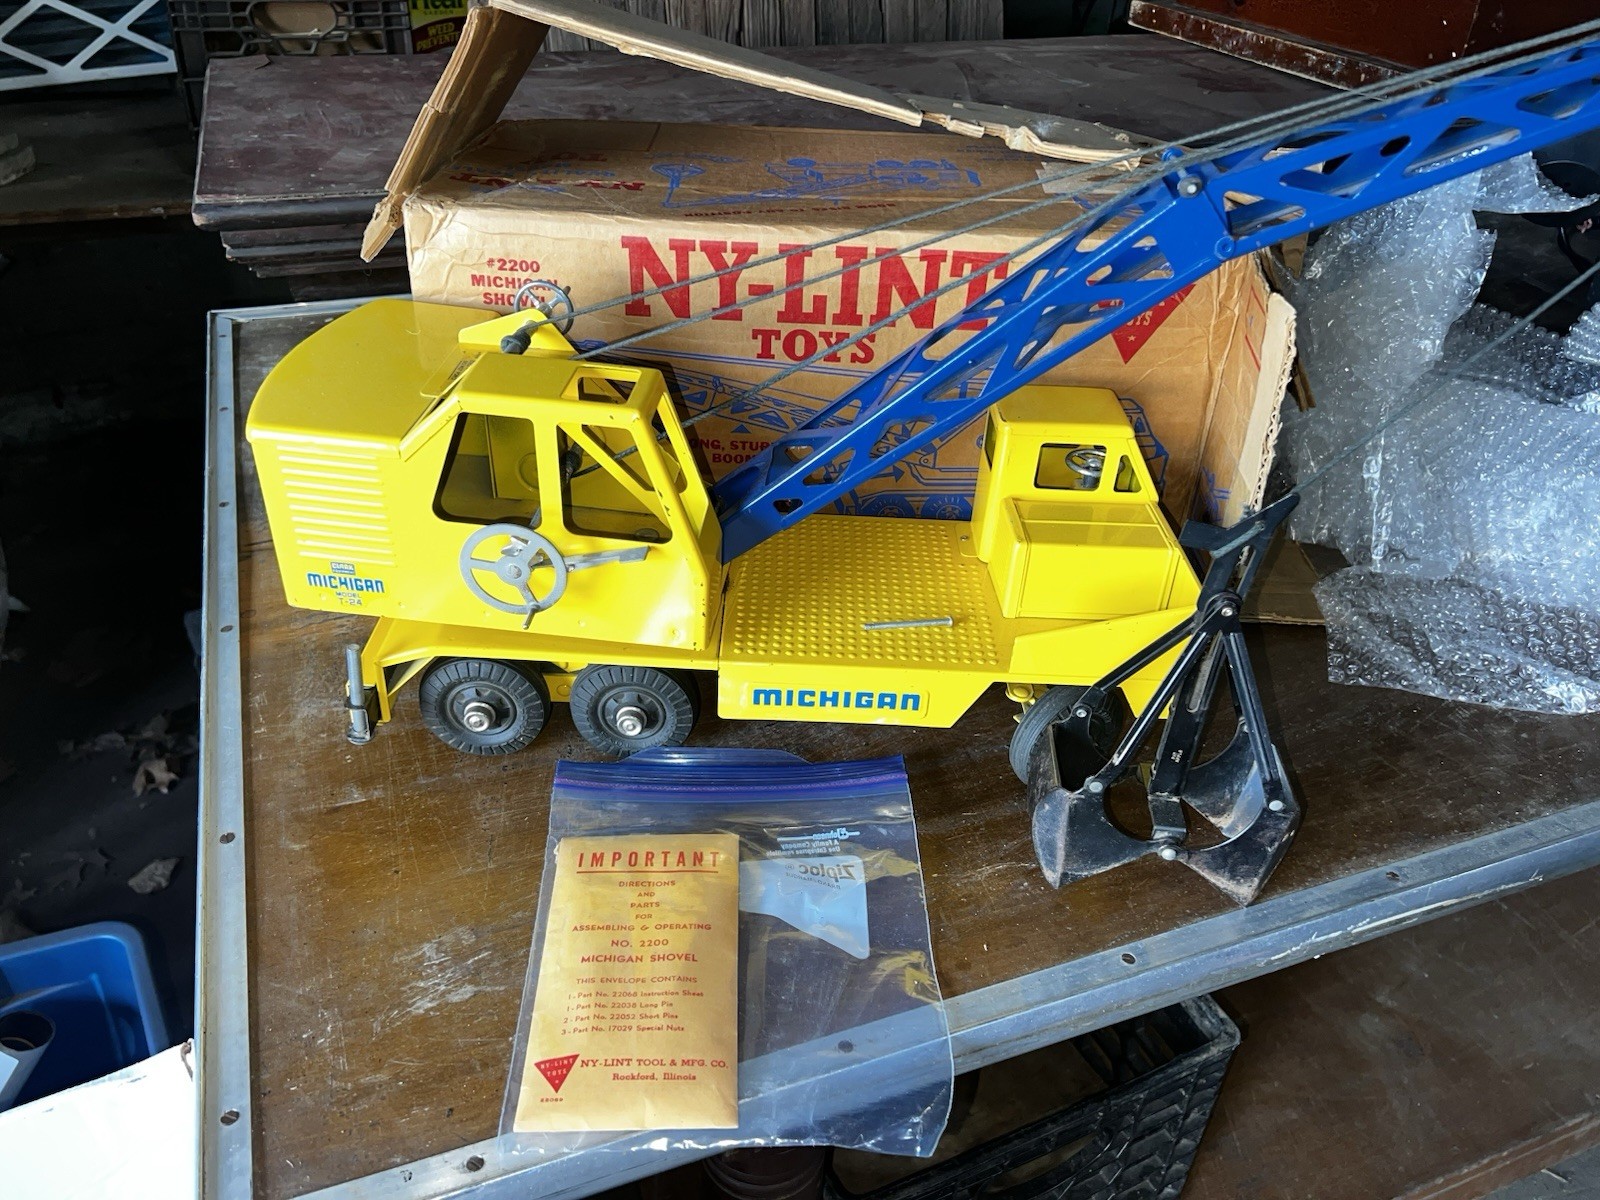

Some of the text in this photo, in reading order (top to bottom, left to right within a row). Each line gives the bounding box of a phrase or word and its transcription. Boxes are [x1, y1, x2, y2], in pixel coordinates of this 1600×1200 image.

[486, 257, 541, 273] #2200
[620, 235, 1010, 331] NY-LINT
[752, 329, 876, 364] TOYS
[307, 572, 385, 593] MICHIGAN
[753, 688, 921, 711] MICHIGAN
[577, 850, 720, 868] IMPORTANT
[572, 924, 635, 932] ASSEMBLING
[655, 923, 712, 931] OPERATING
[611, 938, 669, 948] NO. 2200
[581, 953, 698, 963] MICHIGAN SHOVEL
[600, 976, 646, 984] ENVELOPE
[650, 976, 698, 984] CONTAINS
[682, 989, 704, 997] Sheet
[636, 1024, 664, 1033] Special
[540, 1057, 574, 1069] NY-LINT
[580, 1058, 633, 1068] NY-LINT
[636, 1058, 667, 1067] TOOL
[669, 1058, 677, 1067] &
[681, 1058, 707, 1067] MFG.
[546, 1068, 567, 1077] TOYS
[612, 1072, 697, 1082] Rockford, Illinois
